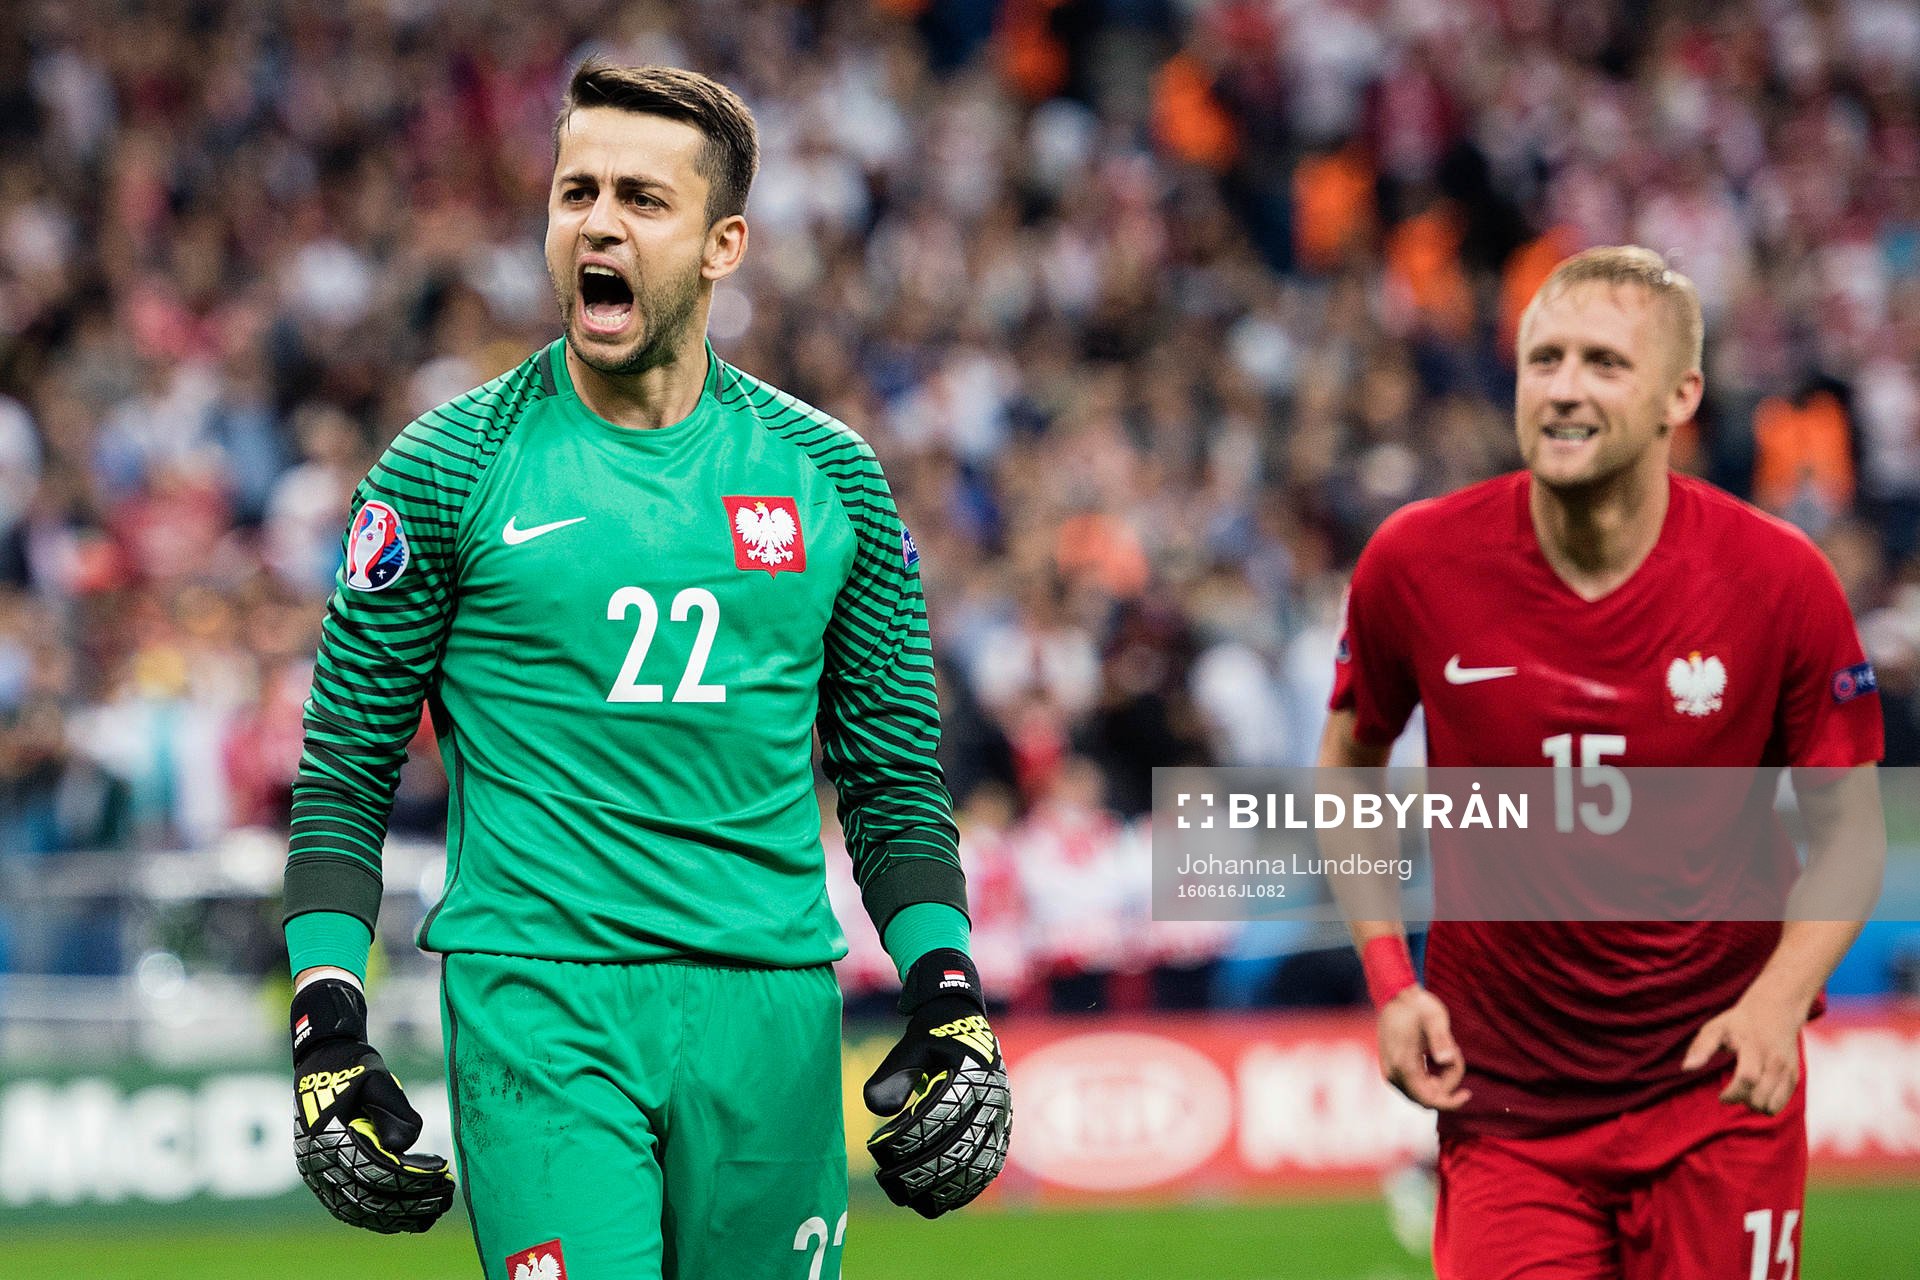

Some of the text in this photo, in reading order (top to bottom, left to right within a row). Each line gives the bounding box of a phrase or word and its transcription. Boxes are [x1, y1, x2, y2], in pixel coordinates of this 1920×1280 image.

[606, 586, 727, 703] 22
[1541, 733, 1633, 836] 15
[298, 1065, 366, 1094] adidas
